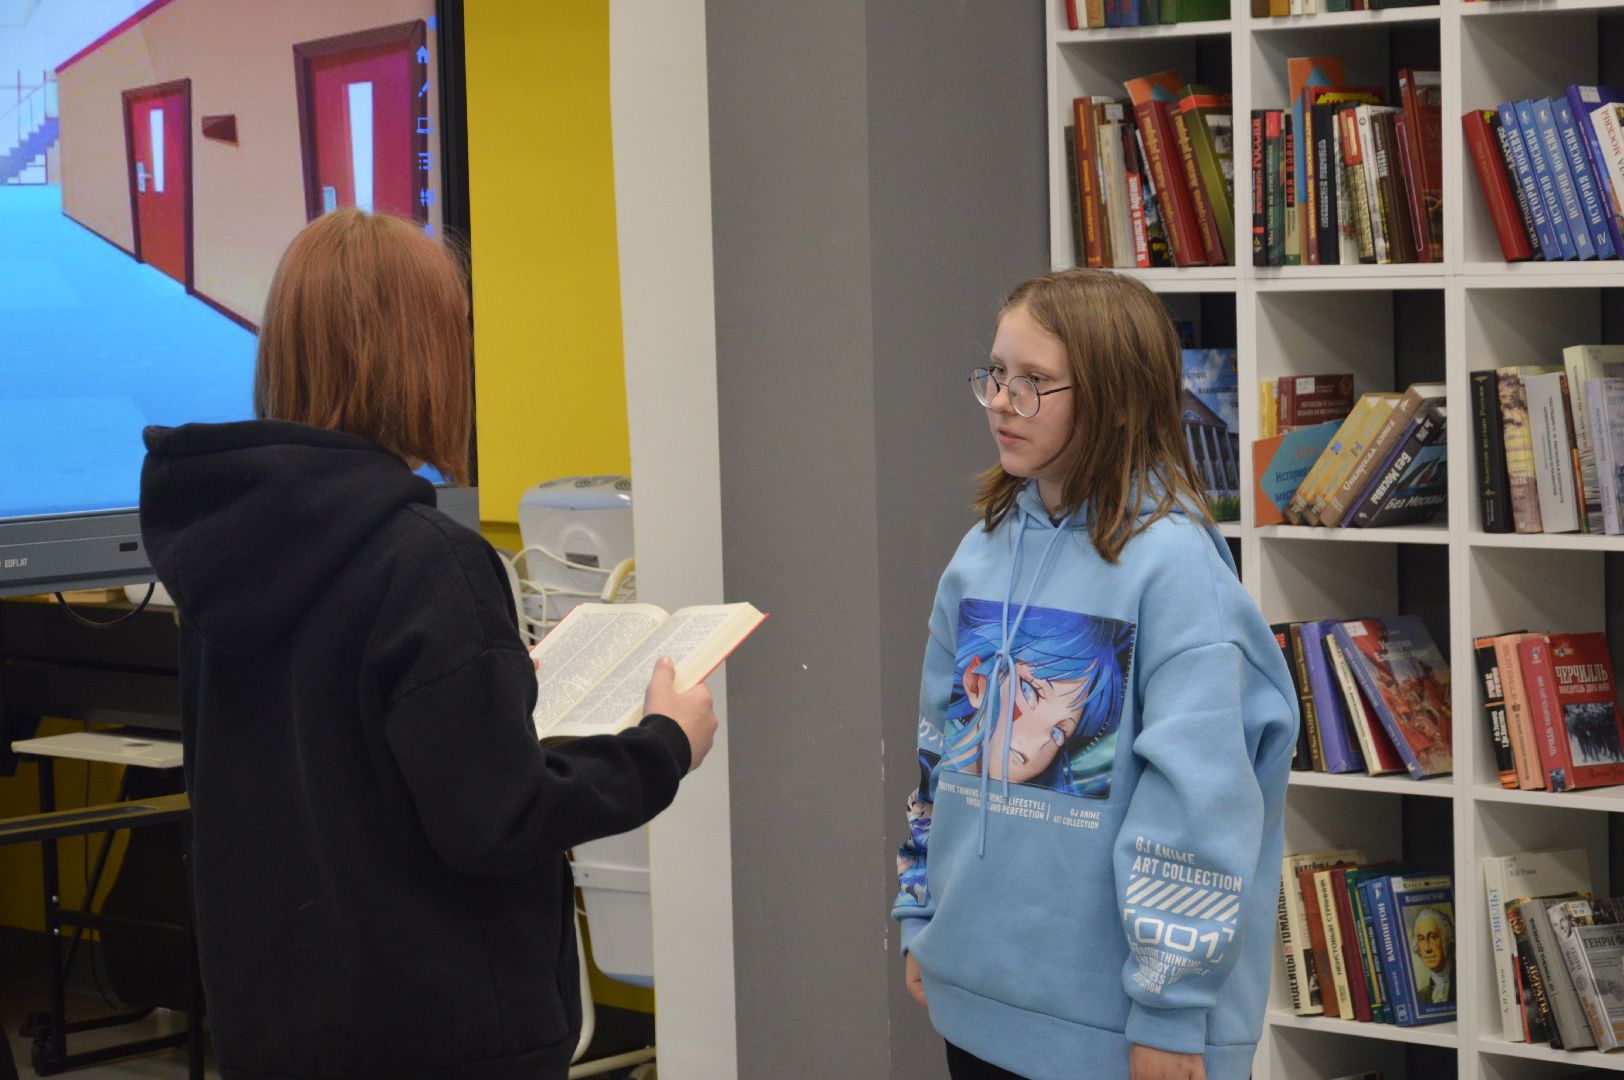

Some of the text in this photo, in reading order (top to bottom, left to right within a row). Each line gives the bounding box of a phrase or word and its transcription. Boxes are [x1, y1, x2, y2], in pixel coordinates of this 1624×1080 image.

[1509, 128, 1527, 174] МОСКВЫ
[1564, 127, 1584, 173] МОСКВЫ
[1602, 109, 1622, 156] МОСКВЫ
[1285, 134, 1294, 203] МОЯ ВОЙНА
[1526, 128, 1562, 224] ИСТОРИЯ МОСКВЫ
[1544, 128, 1579, 219] ИСТОРИЯ МОСКВЫ
[1525, 176, 1546, 224] ИСТОРИЯ
[1581, 175, 1602, 224] ИСТОРИЯ
[1137, 253, 1145, 262] Я
[1369, 452, 1410, 504] Без Москвы
[1384, 498, 1404, 511] Без
[5, 558, 28, 568] EDFLAT
[1554, 664, 1607, 684] ЧЕРЧИЛЛЬ
[1000, 806, 1044, 820] PERFECTION
[1007, 797, 1045, 811] LIFESTYLE
[1061, 817, 1098, 829] COLLECTION
[1078, 809, 1099, 820] ANIME
[1135, 836, 1197, 865] GJ ANIME
[1132, 855, 1242, 893] ART COLLECTION
[1319, 879, 1334, 922] СТРАННИК
[1489, 888, 1504, 953] РУЗВЕЛЬТ
[1134, 917, 1220, 959] 001
[1328, 924, 1343, 976] НЕИСТОВЫЙ
[1378, 902, 1395, 962] ВАШИНГТОН
[1536, 944, 1545, 953] ДО
[1583, 935, 1616, 949] ГЕНРИ
[1528, 965, 1549, 1015] ПИРАТЫ
[1547, 982, 1555, 993] ОТ
